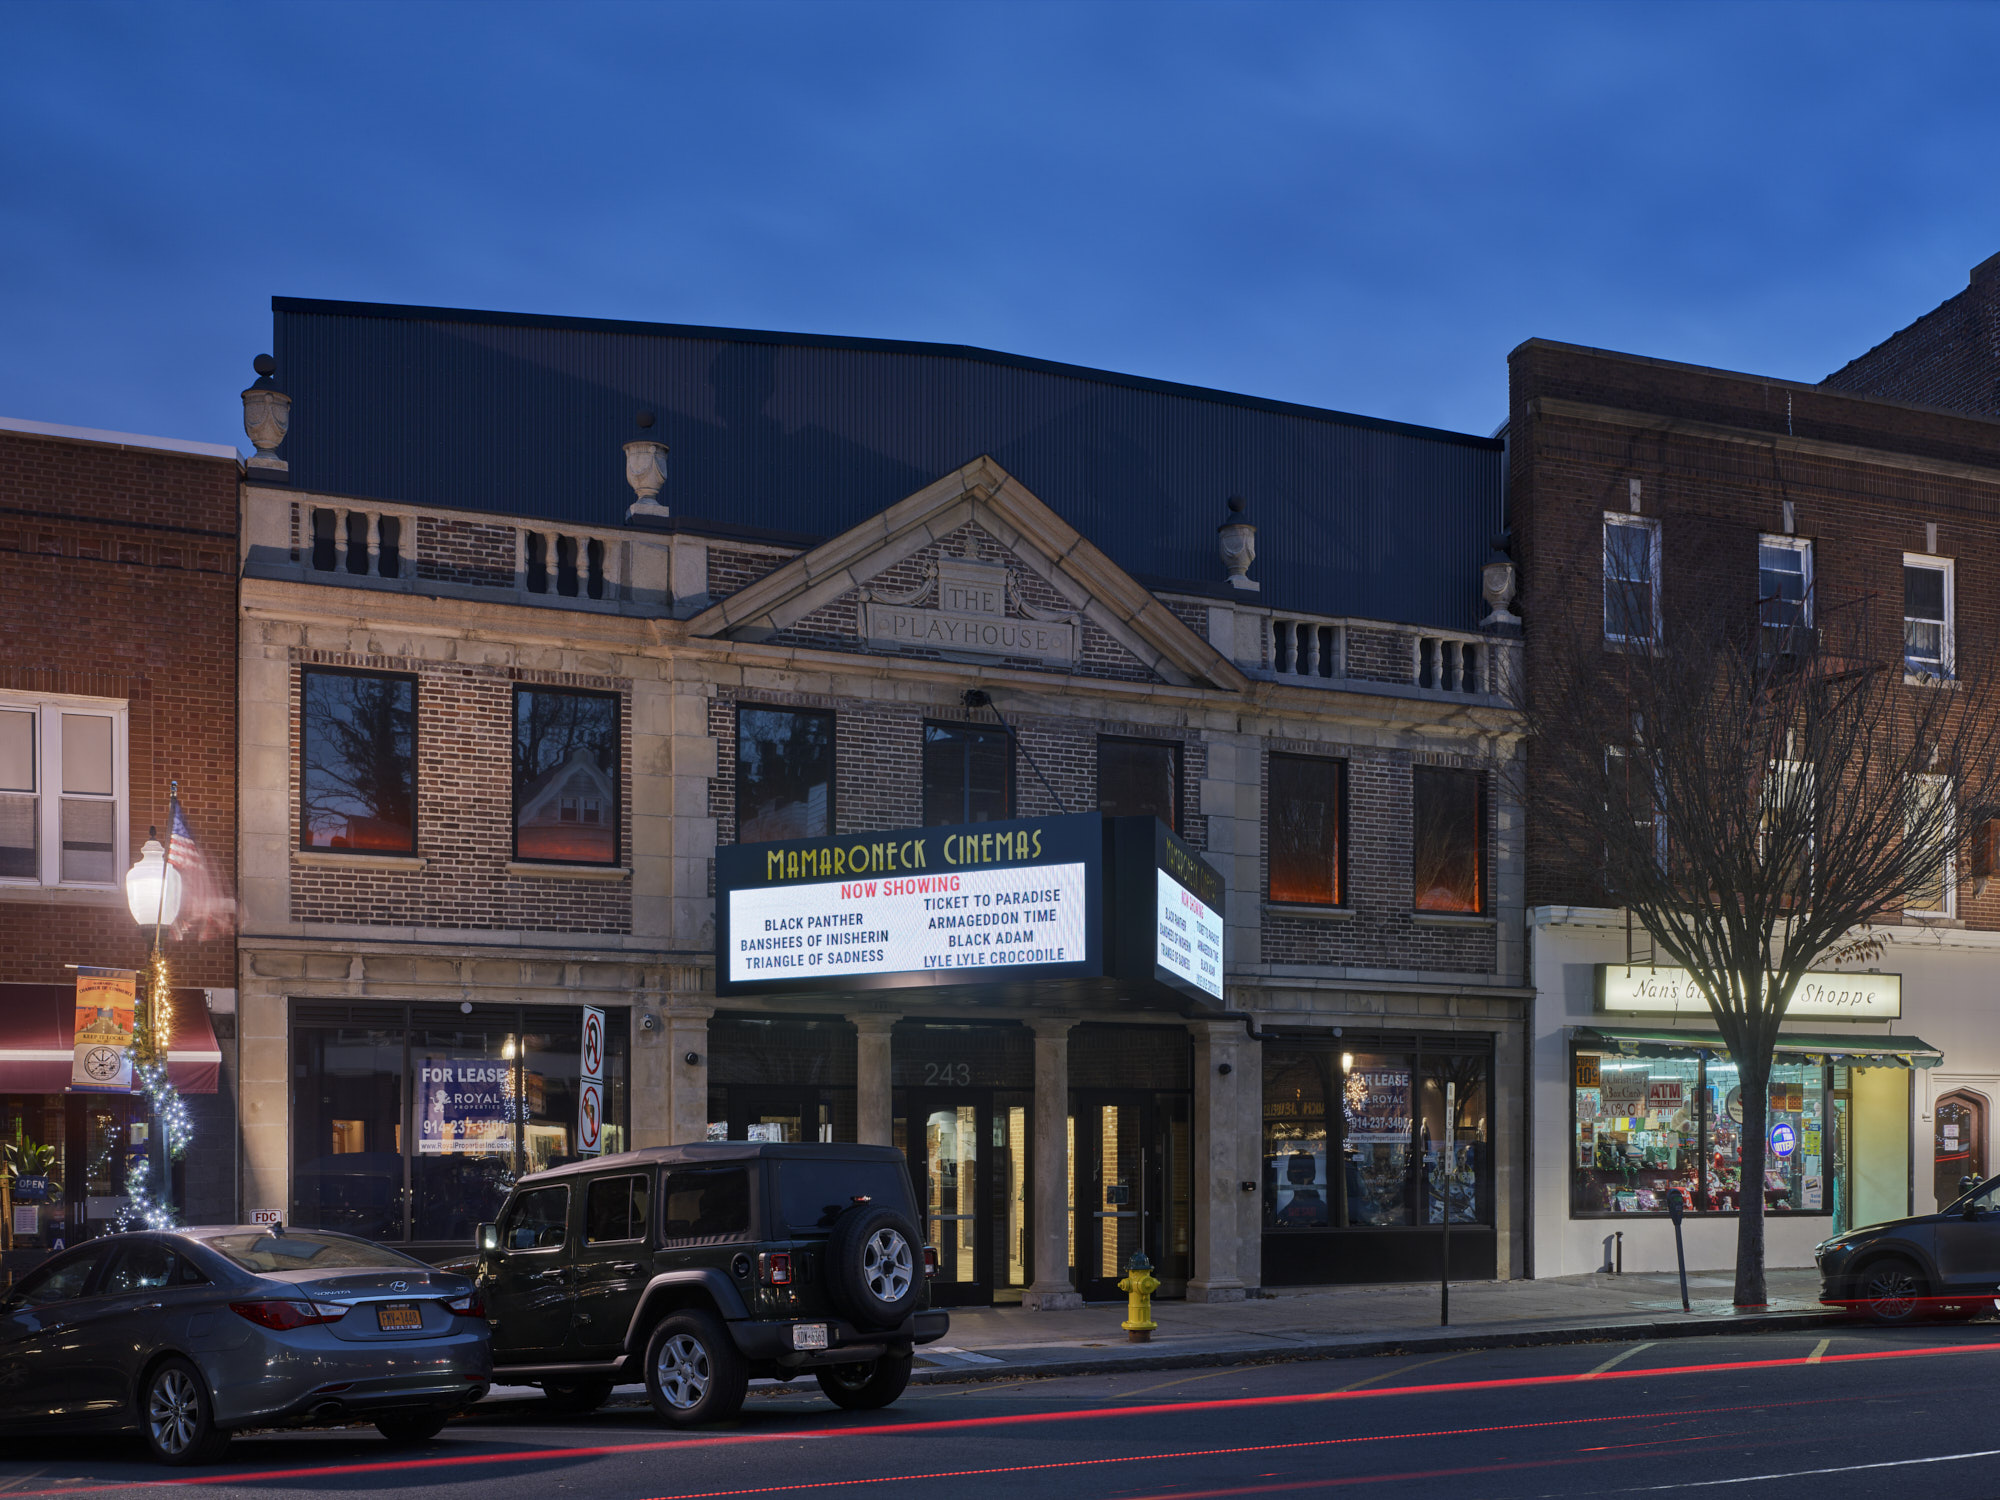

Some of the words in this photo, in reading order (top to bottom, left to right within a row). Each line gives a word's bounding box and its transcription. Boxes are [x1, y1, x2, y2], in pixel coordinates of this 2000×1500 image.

[949, 588, 995, 612] THE
[893, 615, 1049, 650] PLAYHOUSE
[767, 839, 926, 880] MAMARONECK
[943, 828, 1042, 865] CINEMAS
[841, 882, 877, 899] NOW
[883, 875, 960, 897] SHOWING
[924, 896, 969, 911] TICKET
[974, 894, 991, 908] TO
[995, 889, 1061, 905] PARADISE
[765, 917, 803, 931] BLACK
[807, 913, 863, 929] PANTHER
[928, 912, 1019, 929] ARMAGEDDON
[1024, 909, 1057, 923] TIME
[741, 936, 803, 951] BANSHEES
[807, 935, 822, 947] OF
[826, 930, 889, 946] INISHERIN
[949, 932, 991, 947] BLACK
[995, 930, 1034, 944] ADAM
[745, 954, 804, 969] TRIANGLE
[808, 953, 823, 965] OF
[827, 949, 884, 965] SADNESS
[924, 954, 952, 968] LYLE
[956, 952, 985, 966] LYLE
[990, 947, 1065, 964] CROCODILE
[1633, 979, 1678, 998] Nan's
[1801, 984, 1876, 1005] Shoppe
[422, 1068, 453, 1083] FOR
[458, 1068, 505, 1083] LEASE
[924, 1063, 971, 1087] 243
[1375, 1074, 1409, 1087] LEASE
[454, 1093, 500, 1104] ROYAL
[1372, 1094, 1404, 1104] ROYAL
[1650, 1084, 1681, 1098] ATM
[1578, 1103, 1596, 1117] FAX
[1627, 1102, 1646, 1117] OFF
[19, 1179, 45, 1189] OPEN
[255, 1212, 277, 1223] FDC
[53, 1238, 65, 1250] A
